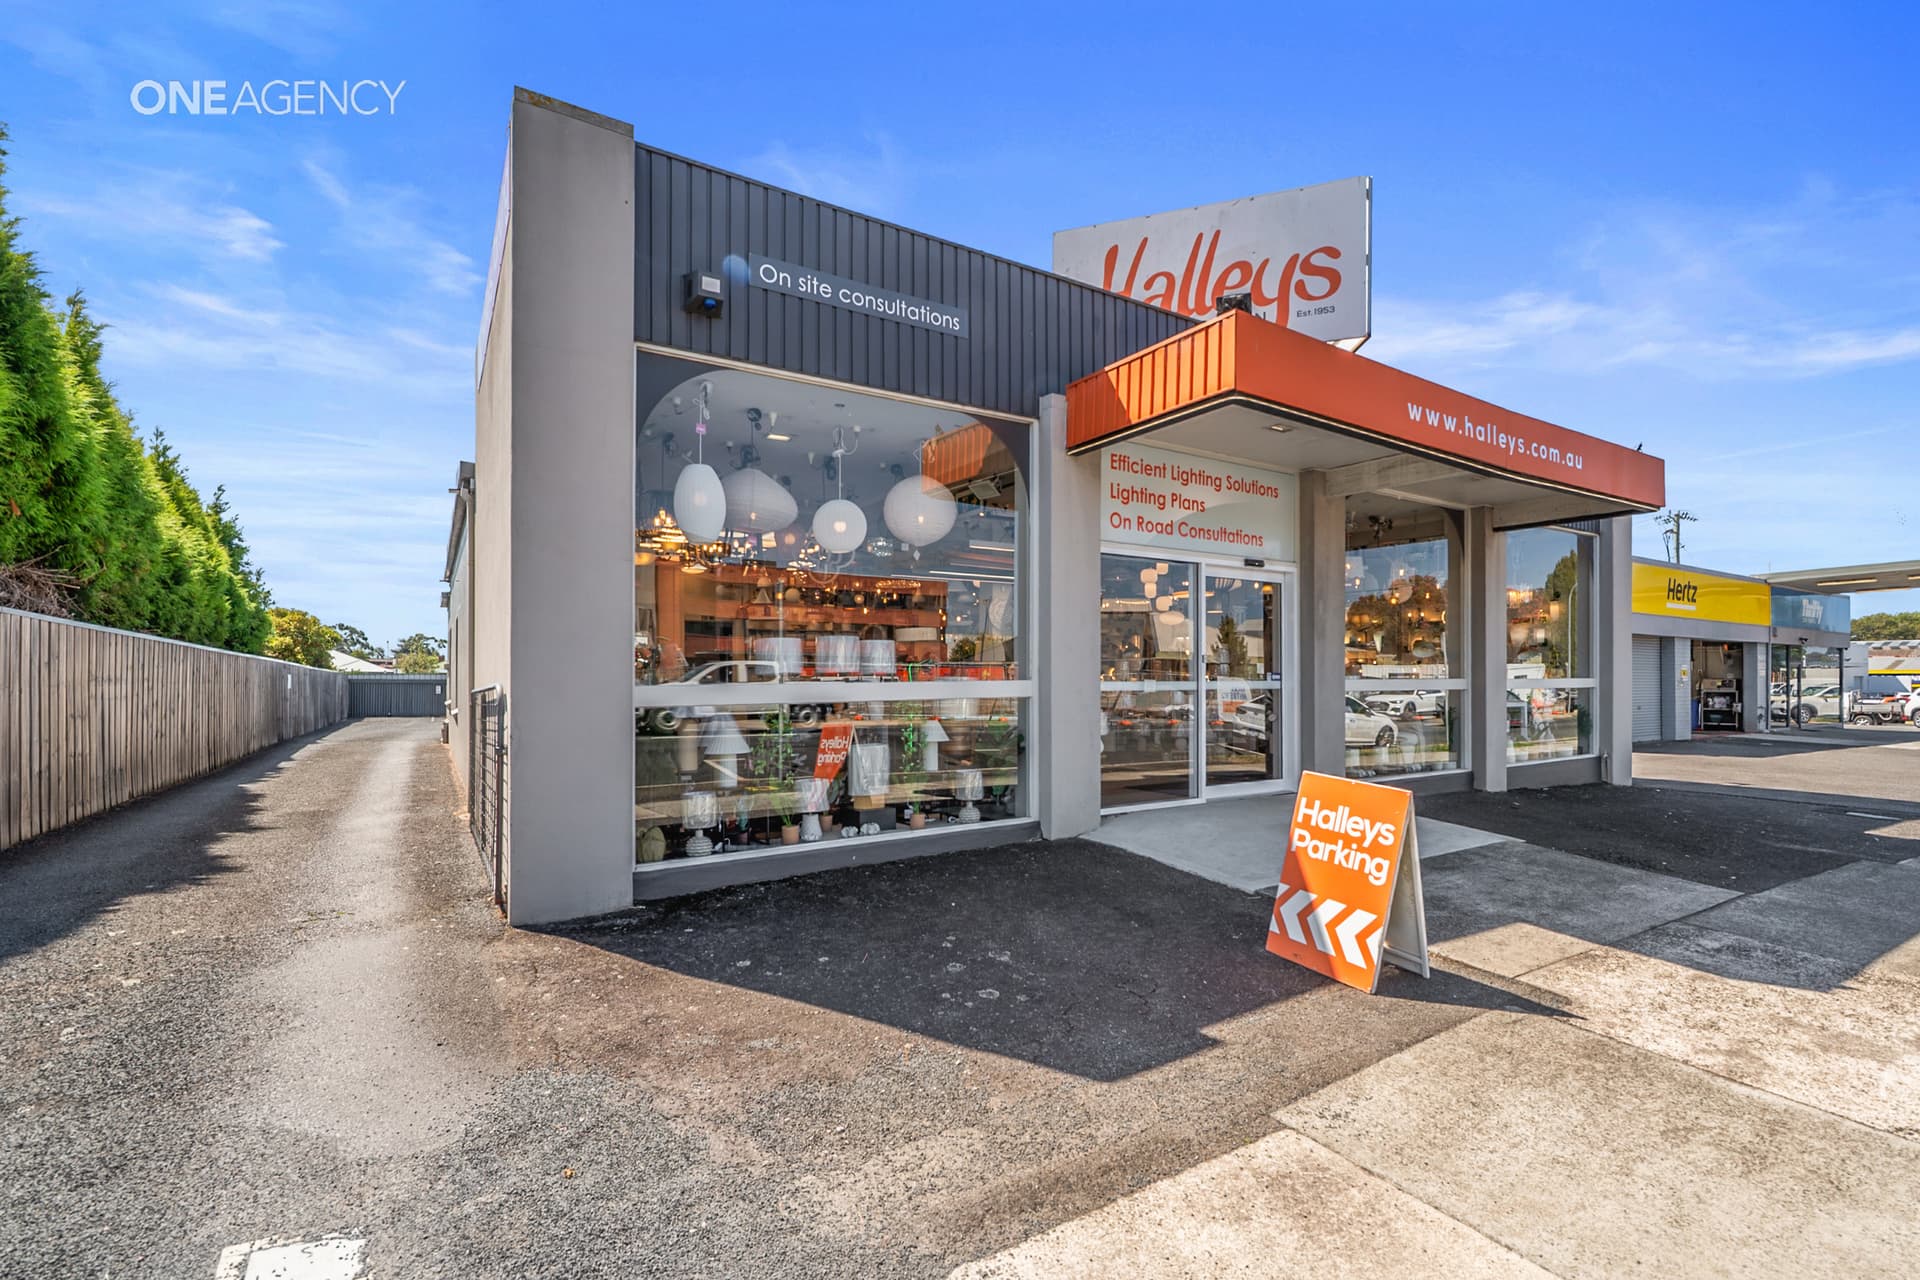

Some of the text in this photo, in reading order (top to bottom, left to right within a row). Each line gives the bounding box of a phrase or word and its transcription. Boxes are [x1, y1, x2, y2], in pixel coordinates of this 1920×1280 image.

[760, 264, 960, 330] On site consultations
[1407, 402, 1583, 470] www.halleys.com.au
[1110, 453, 1279, 499] Efficient Lighting Solutions
[1110, 482, 1206, 512] Lighting Plans
[1110, 512, 1264, 547] On Road Consultations
[1667, 577, 1698, 603] Hertz
[1297, 797, 1396, 847] Halleys
[1291, 828, 1390, 886] Parking
